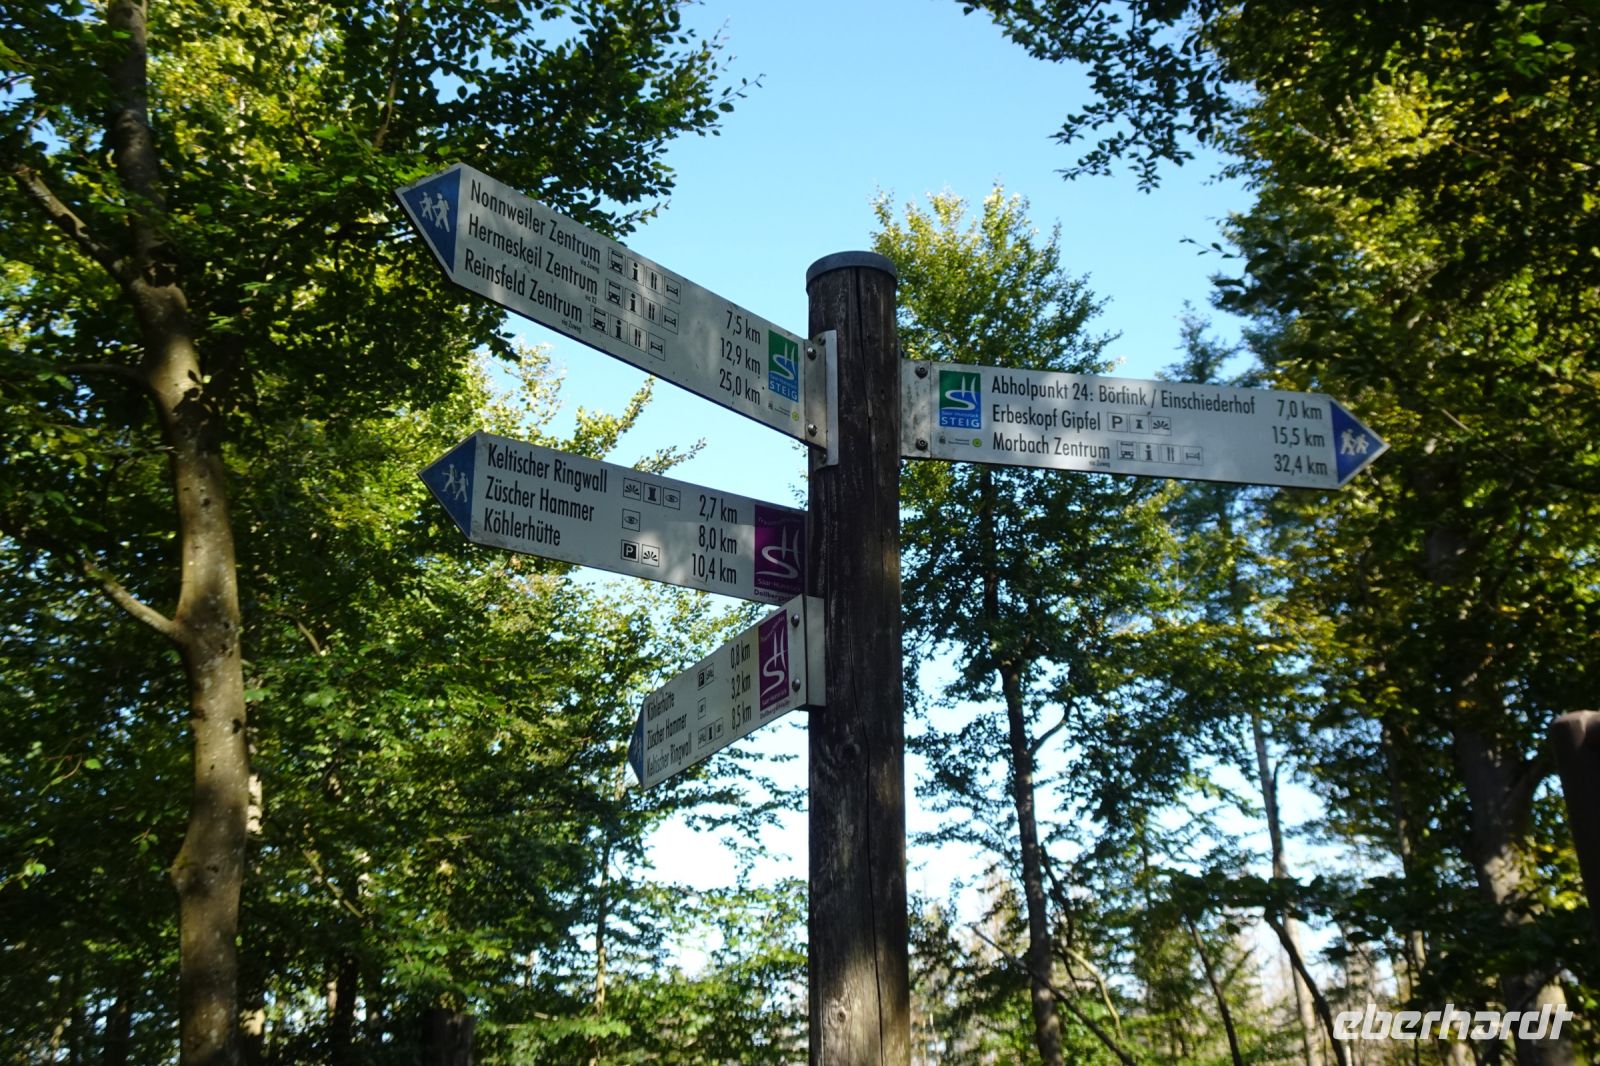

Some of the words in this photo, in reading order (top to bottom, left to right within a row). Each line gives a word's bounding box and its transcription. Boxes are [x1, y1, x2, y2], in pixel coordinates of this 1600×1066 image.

[471, 178, 545, 236] Nonnweiler
[548, 219, 601, 264] Zentrum
[468, 213, 543, 269] Hermeskeil
[545, 251, 598, 296] Zentrum
[465, 248, 526, 297] Reinsfeld
[529, 278, 583, 323] Zentrum
[726, 310, 742, 336] 7,5
[745, 319, 761, 345] km
[720, 337, 741, 367] 12,9
[745, 347, 761, 375] km
[719, 368, 742, 397] 25,0
[745, 378, 761, 405] km
[769, 380, 798, 401] STEIG
[992, 376, 1068, 400] Abholpunkt
[1072, 382, 1094, 402] 24:
[1099, 384, 1147, 406] Börfink
[1161, 390, 1256, 415] Einschiederhof
[941, 417, 980, 428] STEIG
[992, 404, 1058, 431] Erbeskopf
[1062, 410, 1101, 433] Gipfel
[1277, 399, 1298, 420] 7,0
[1302, 401, 1322, 420] km
[993, 432, 1049, 454] Morbach
[1054, 437, 1110, 460] Zentrum
[1272, 425, 1300, 447] 15,5
[1305, 427, 1325, 448] km
[487, 443, 550, 479] Keltischer
[553, 458, 608, 493] Ringwall
[1274, 454, 1303, 475] 32,4
[1307, 456, 1328, 475] km
[485, 475, 536, 513] Züscher
[539, 487, 595, 522] Hammer
[699, 494, 717, 523] 2,7
[720, 500, 738, 525] km
[483, 507, 561, 546] Köhlerhütte
[698, 524, 716, 553] 8,0
[720, 528, 737, 555] km
[691, 553, 716, 583] 10,4
[719, 558, 737, 584] km
[730, 645, 741, 669] 0,8
[741, 640, 751, 663] km
[730, 676, 741, 700] 3,2
[741, 672, 751, 692] km
[665, 713, 687, 743] Hammer
[731, 706, 742, 731] 8,5
[742, 703, 752, 723] km
[670, 732, 692, 766] Ringwall
